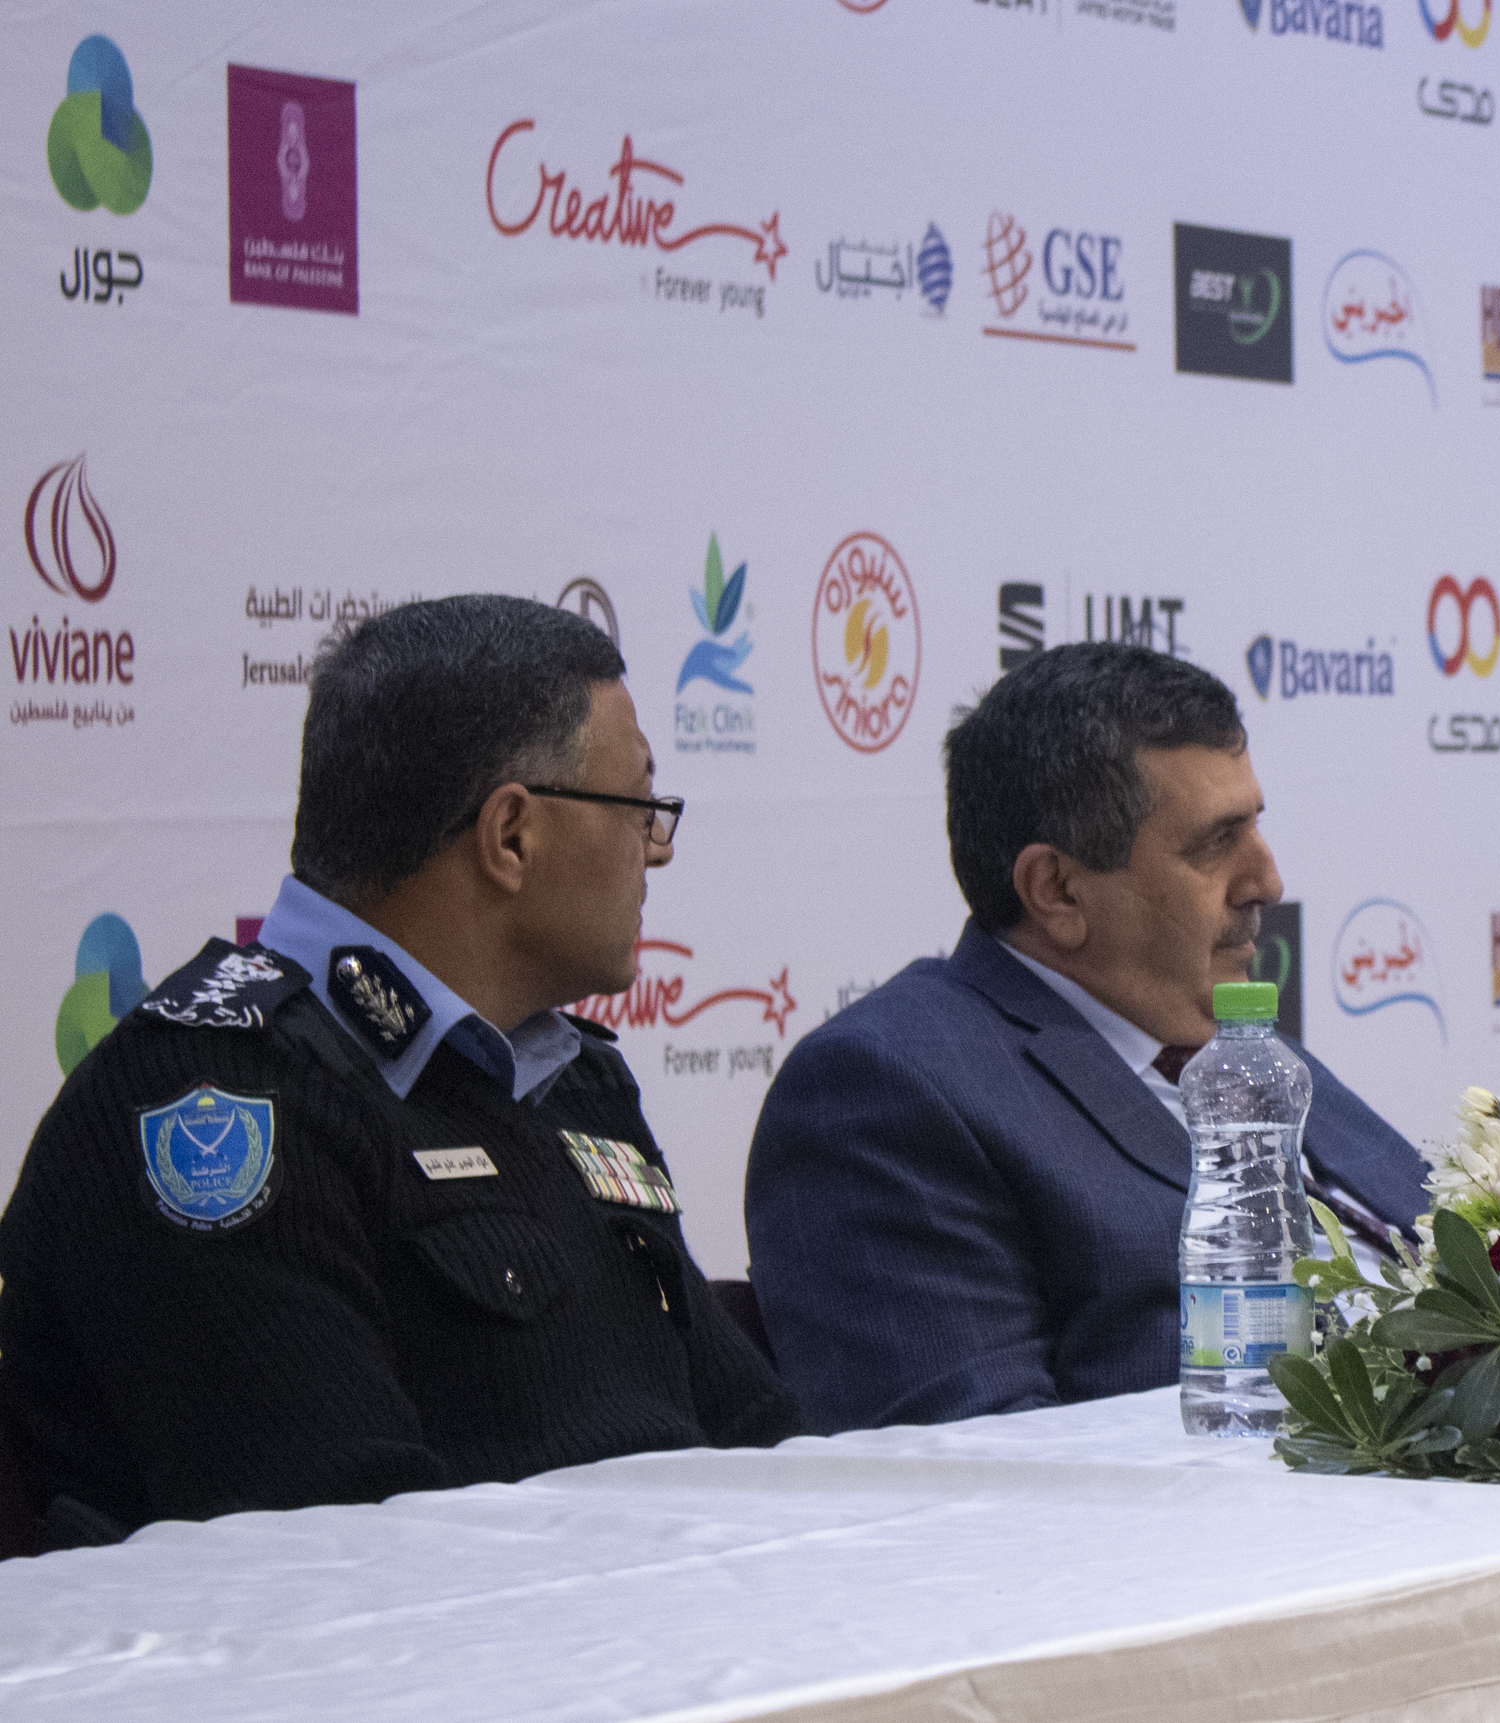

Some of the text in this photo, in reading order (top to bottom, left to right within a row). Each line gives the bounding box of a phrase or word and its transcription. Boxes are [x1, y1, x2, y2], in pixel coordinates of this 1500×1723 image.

[487, 119, 772, 256] Creative
[61, 246, 144, 305] جوال
[243, 261, 343, 288] BANK OF PALESTINE
[655, 266, 766, 318] Forever young
[1043, 227, 1125, 302] GSE
[9, 614, 135, 686] viviane
[243, 652, 314, 690] Jerusale
[1279, 637, 1395, 699] Bavaria
[663, 1043, 774, 1078] Forever young
[190, 1176, 233, 1189] POLICE
